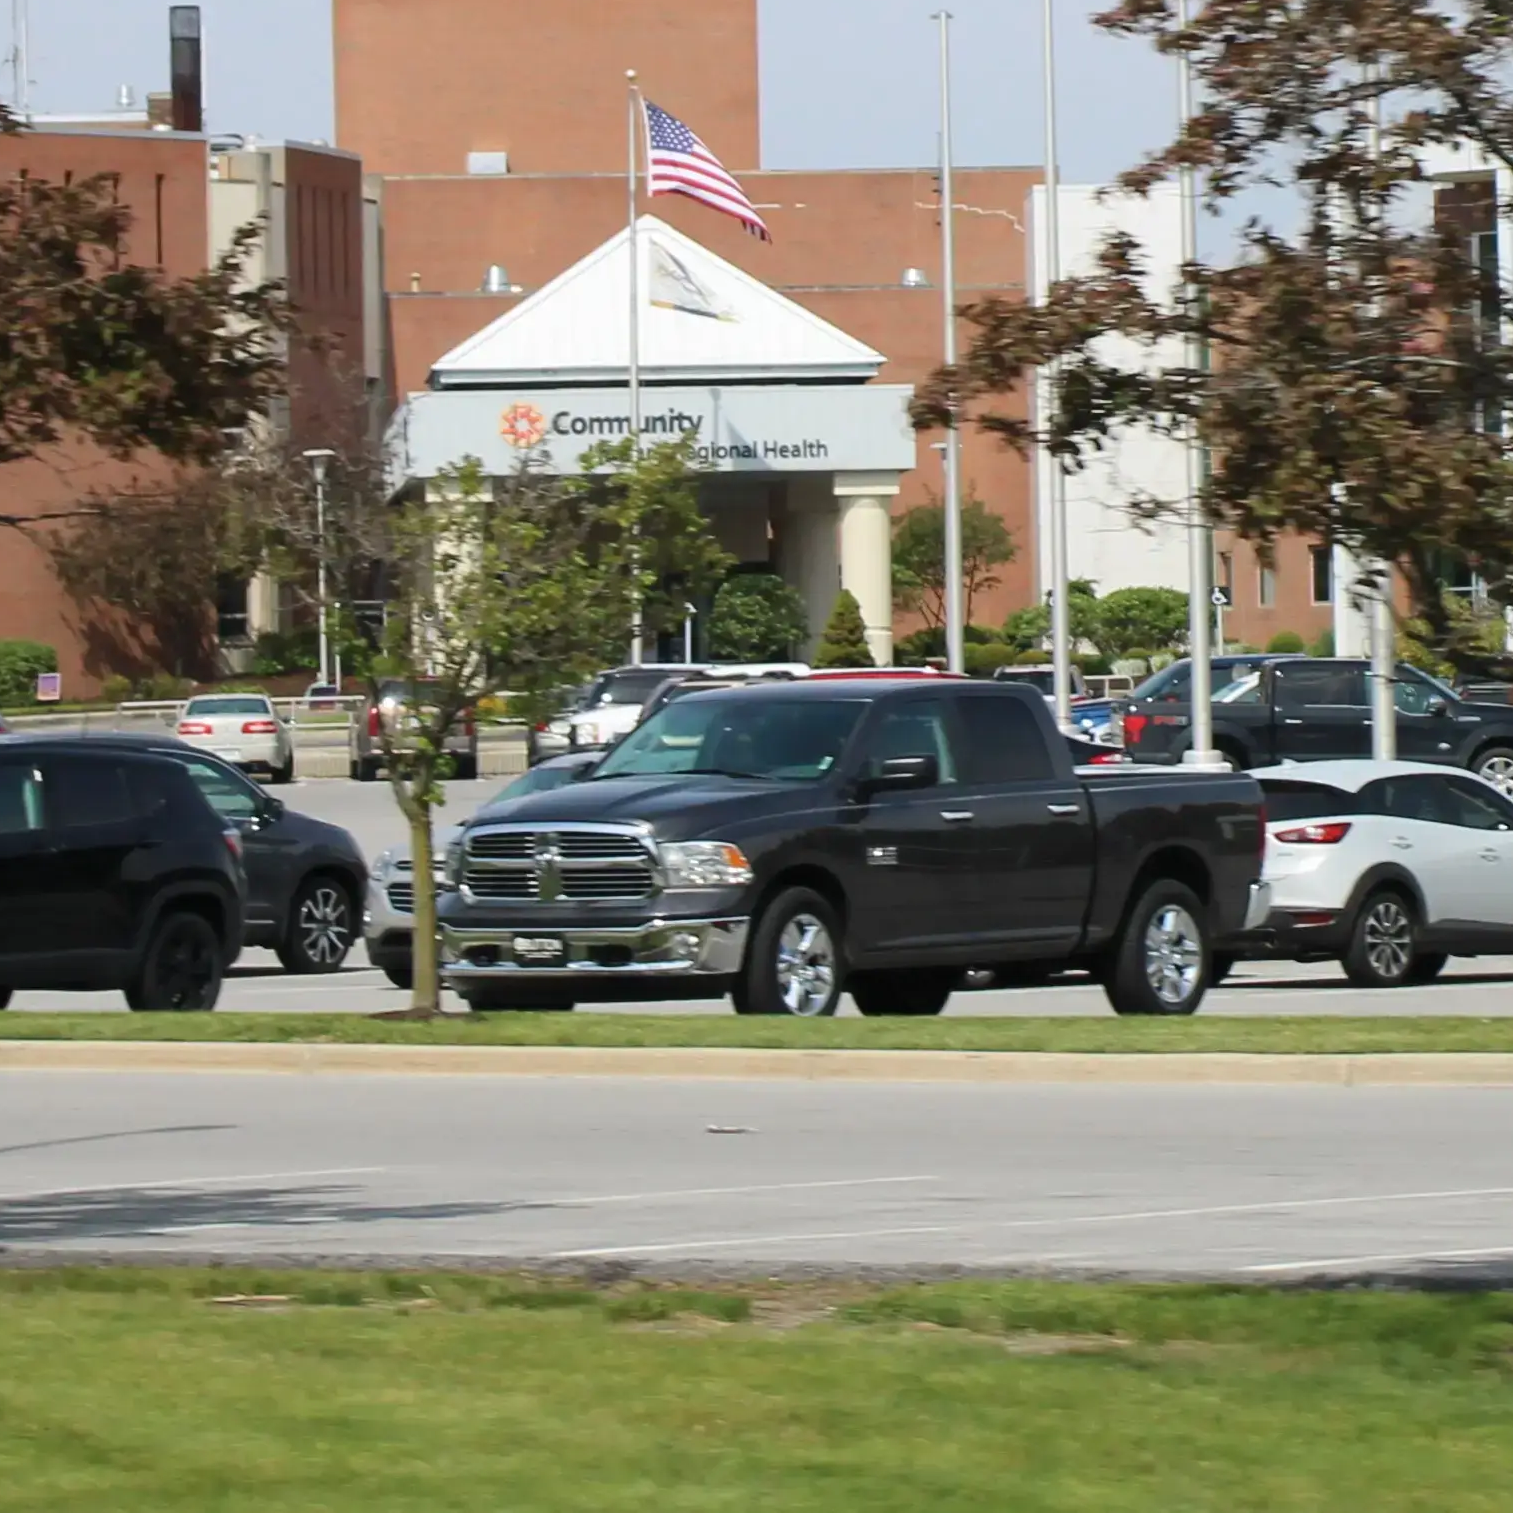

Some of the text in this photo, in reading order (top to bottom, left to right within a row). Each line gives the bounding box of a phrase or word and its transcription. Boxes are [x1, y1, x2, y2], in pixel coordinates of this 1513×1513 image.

[552, 407, 704, 437] Community
[677, 440, 758, 465] egional
[763, 439, 829, 460] Health
